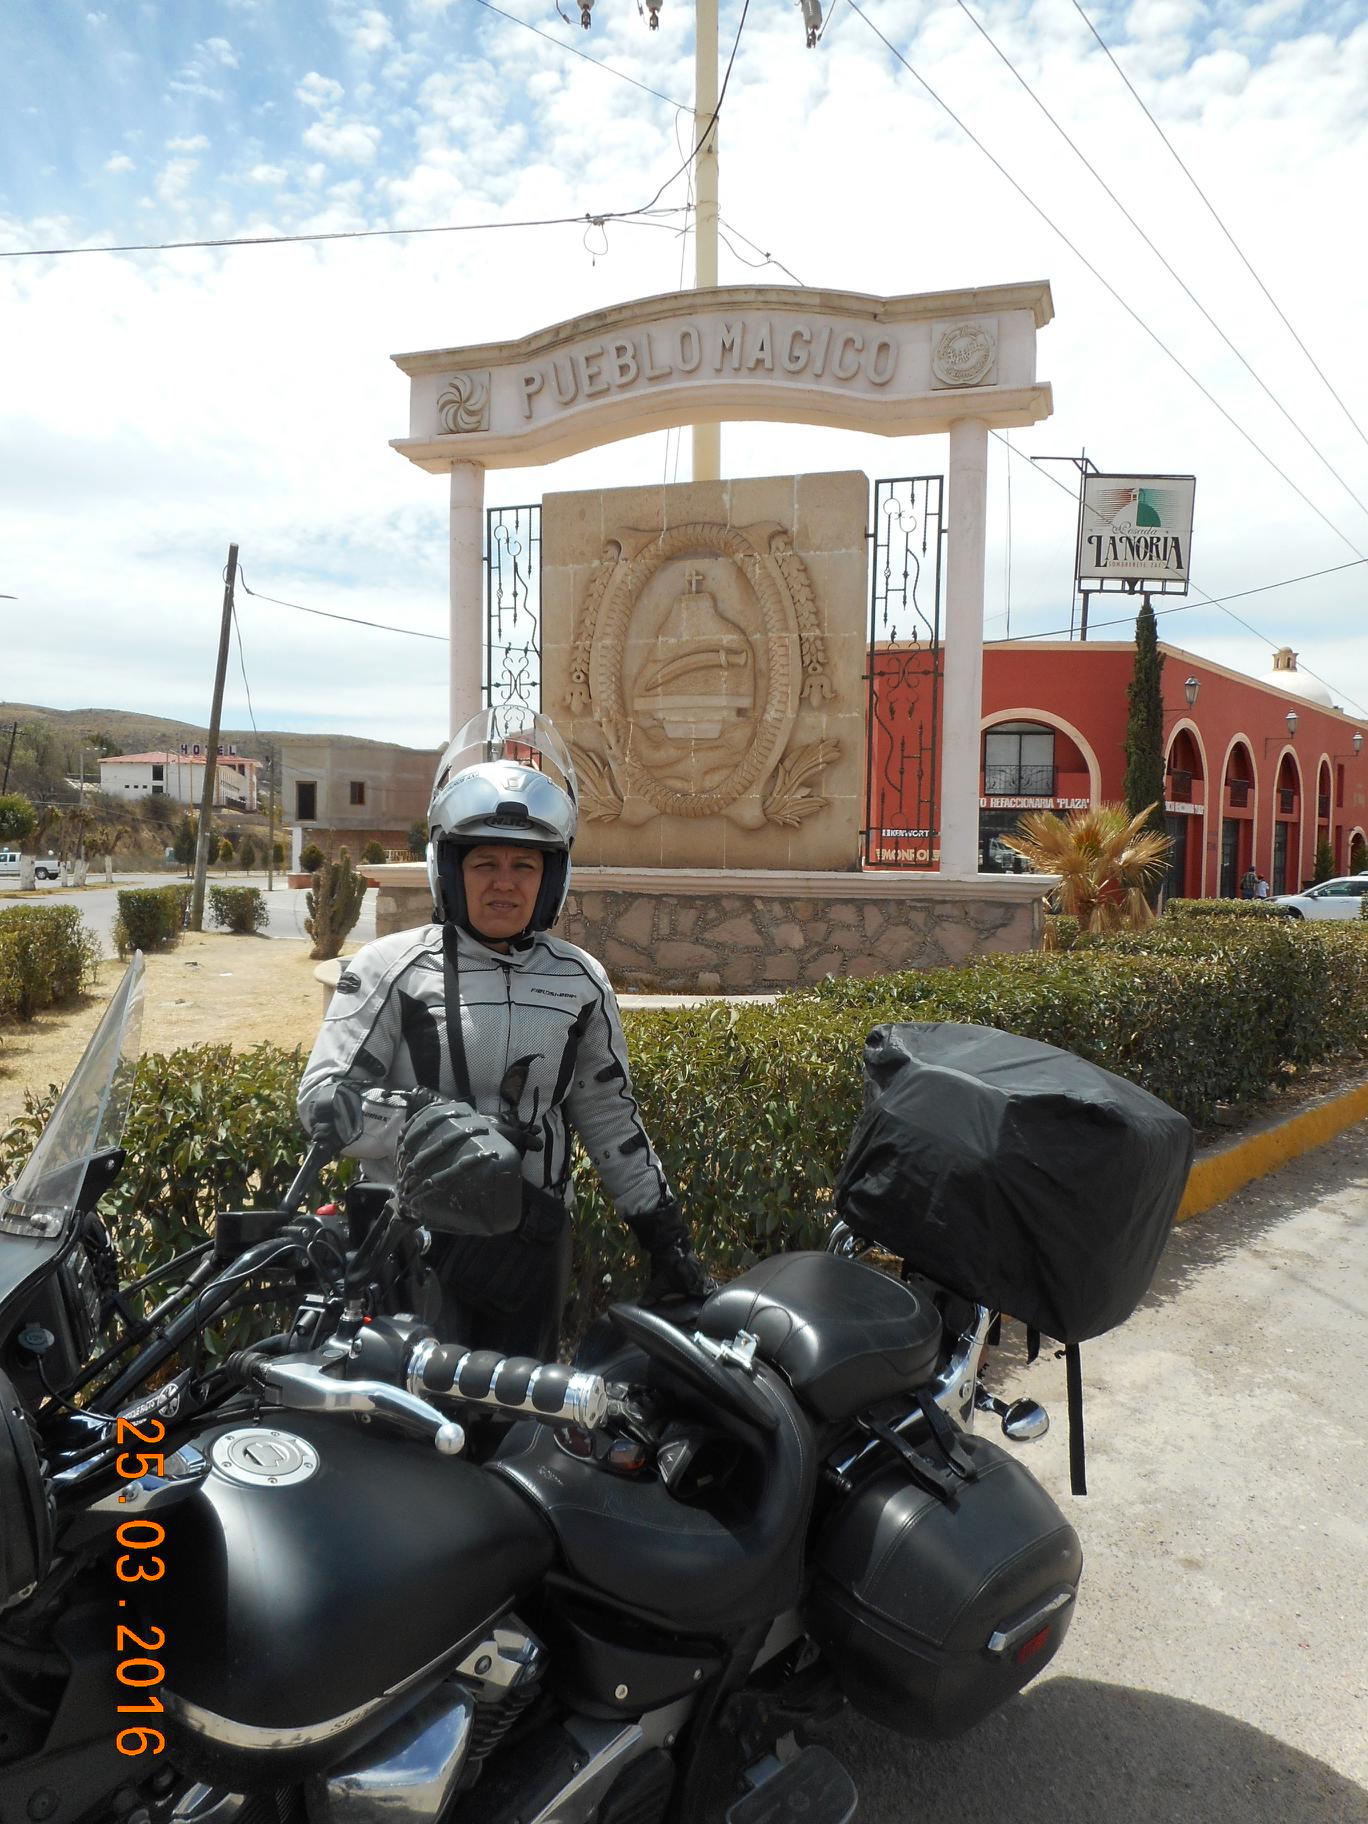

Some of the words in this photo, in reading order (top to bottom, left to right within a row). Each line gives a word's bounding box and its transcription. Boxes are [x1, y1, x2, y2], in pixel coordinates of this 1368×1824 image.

[518, 324, 702, 420] PUEBLO
[713, 319, 899, 386] MAGICO
[1087, 535, 1119, 568] LA
[1119, 535, 1184, 569] NORIA
[181, 744, 237, 756] HOEL
[990, 797, 1054, 808] REFACCIONARIA
